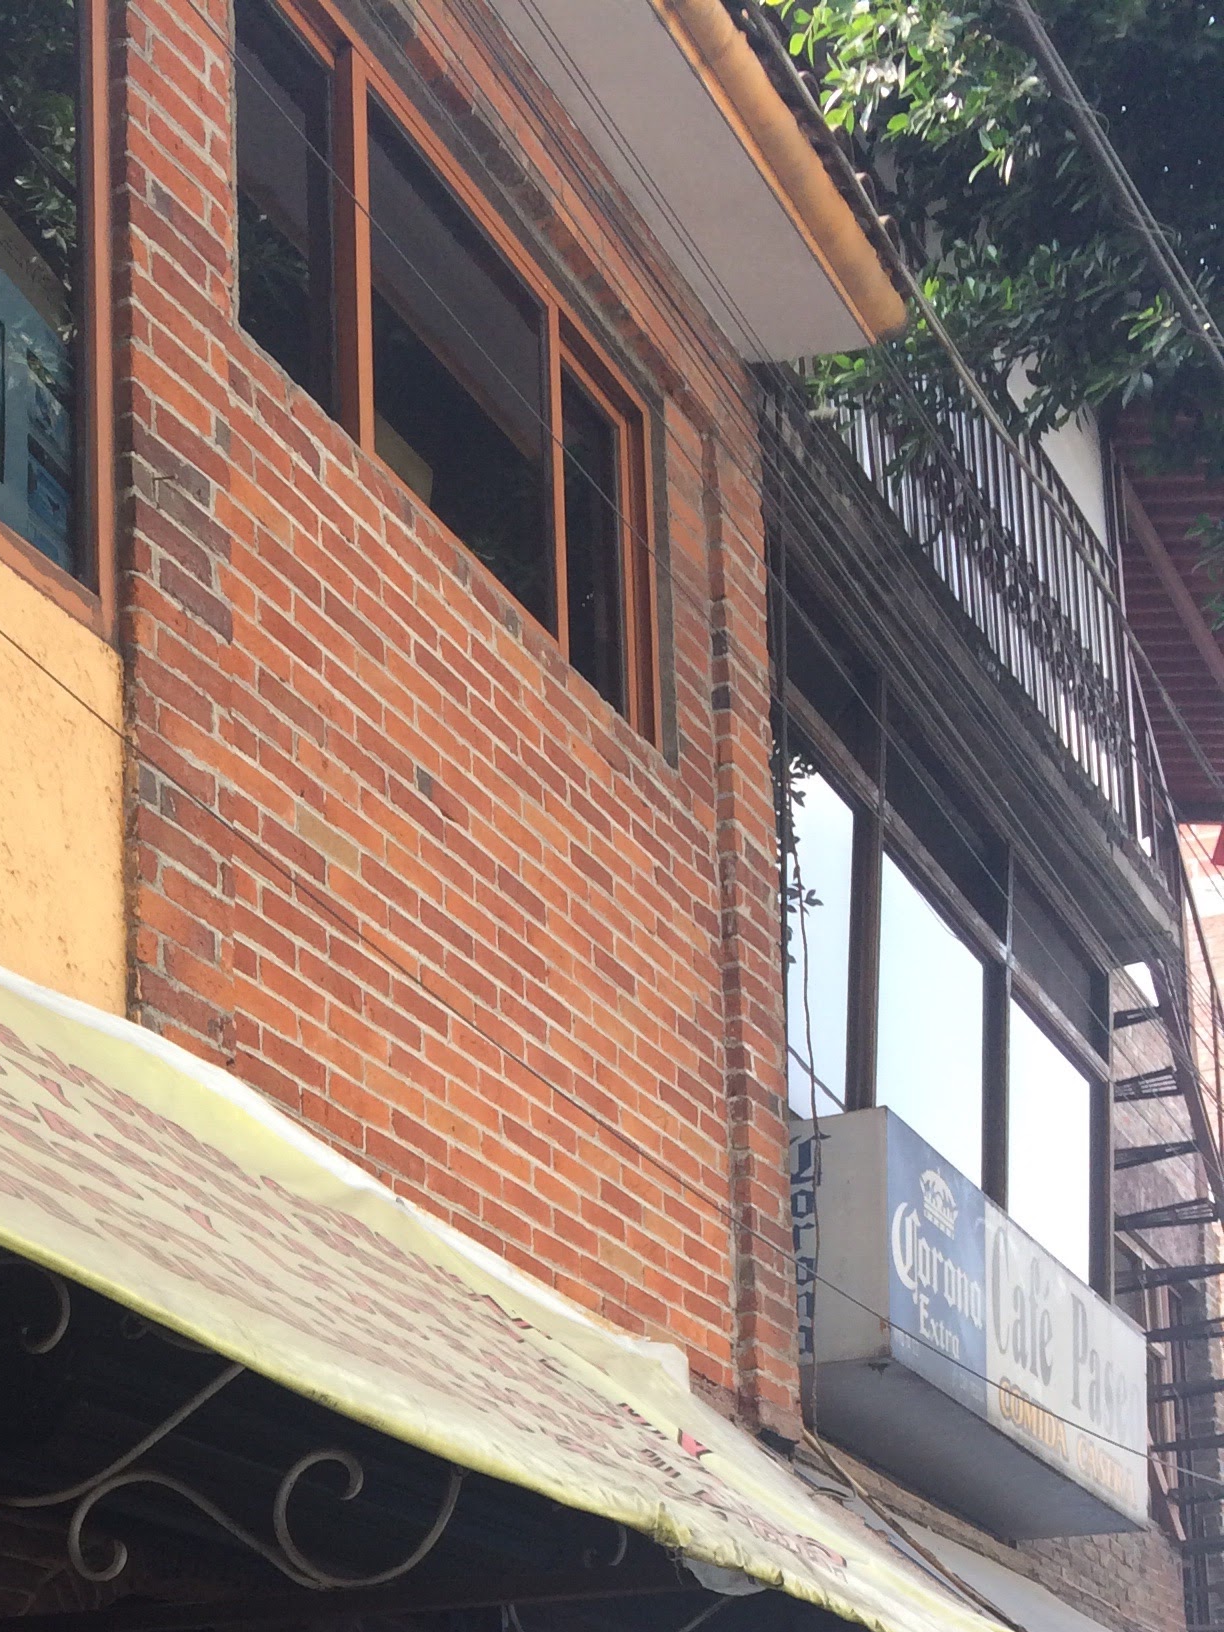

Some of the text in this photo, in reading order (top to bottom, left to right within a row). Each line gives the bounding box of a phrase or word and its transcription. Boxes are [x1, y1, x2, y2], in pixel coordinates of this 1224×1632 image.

[2, 1055, 79, 1113] Y
[84, 1097, 301, 1235] BUEN
[135, 1180, 231, 1244] Y
[891, 1201, 984, 1330] Corona
[919, 1293, 961, 1360] Extra
[991, 1225, 1054, 1387] Café
[998, 1376, 1070, 1464] COMIDA
